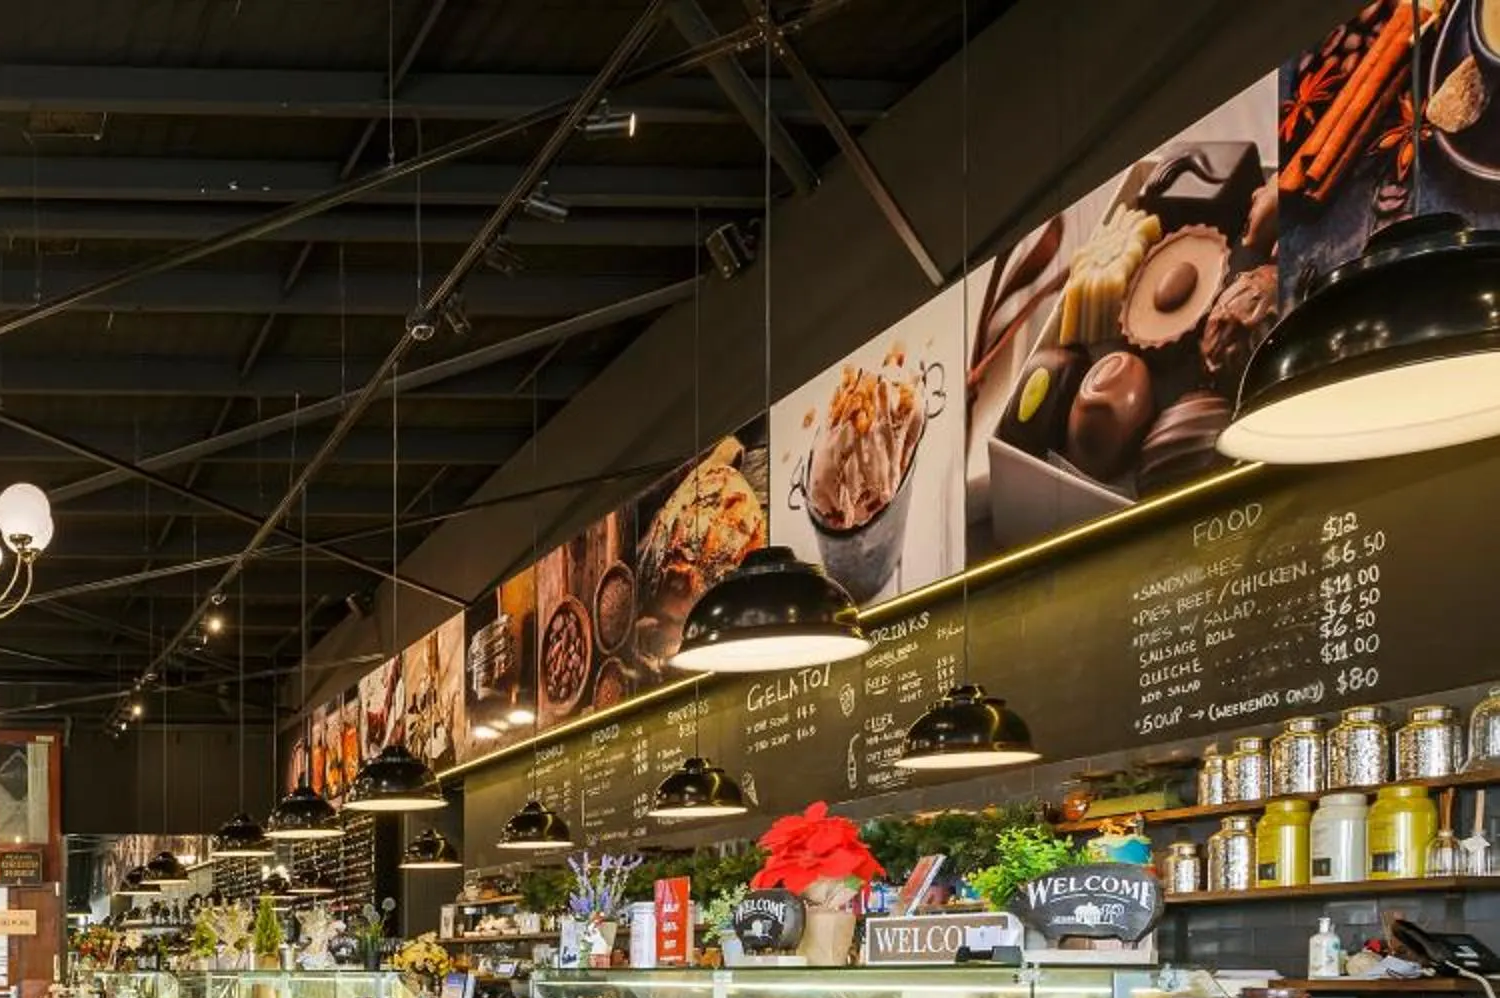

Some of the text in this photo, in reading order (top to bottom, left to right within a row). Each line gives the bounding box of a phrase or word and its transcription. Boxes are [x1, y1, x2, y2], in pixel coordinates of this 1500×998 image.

[1193, 503, 1262, 547] FOOD
[1321, 511, 1359, 543] $12
[1139, 604, 1172, 626] PIES
[1321, 530, 1386, 570] $6.50
[1139, 626, 1173, 647] PIES
[1203, 600, 1255, 630] SALAD
[1320, 564, 1380, 598] $11.00
[868, 611, 930, 650] DRINKS
[1140, 587, 1380, 669] SAUSAGE ROLL $6.50
[1140, 610, 1376, 687] QUICHE $6.50
[1140, 633, 1380, 705] ADD SALAD $11.00
[1139, 705, 1183, 735] SOUP
[735, 898, 787, 925] WELCOME
[1027, 875, 1153, 910] WELCOME
[874, 924, 1002, 955] WELCO
